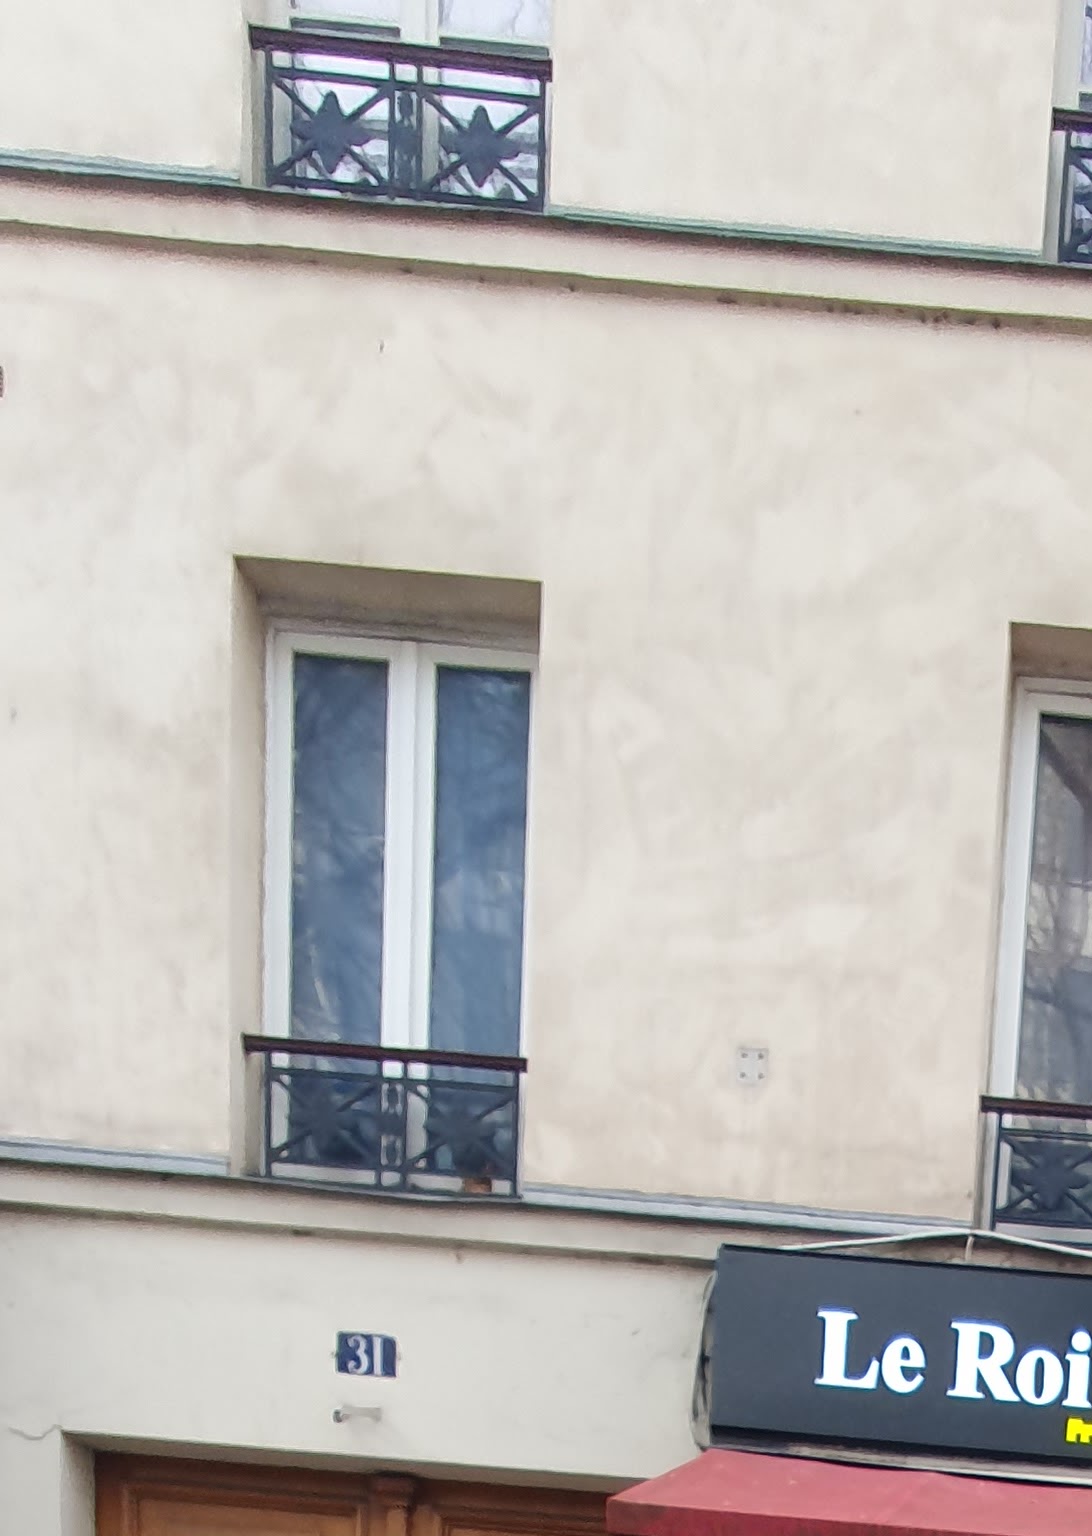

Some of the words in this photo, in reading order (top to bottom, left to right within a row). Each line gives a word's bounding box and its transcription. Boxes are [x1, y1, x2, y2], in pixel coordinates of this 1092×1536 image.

[347, 1334, 381, 1376] 31
[814, 1306, 926, 1394] Le
[946, 1318, 1092, 1409] Roi
